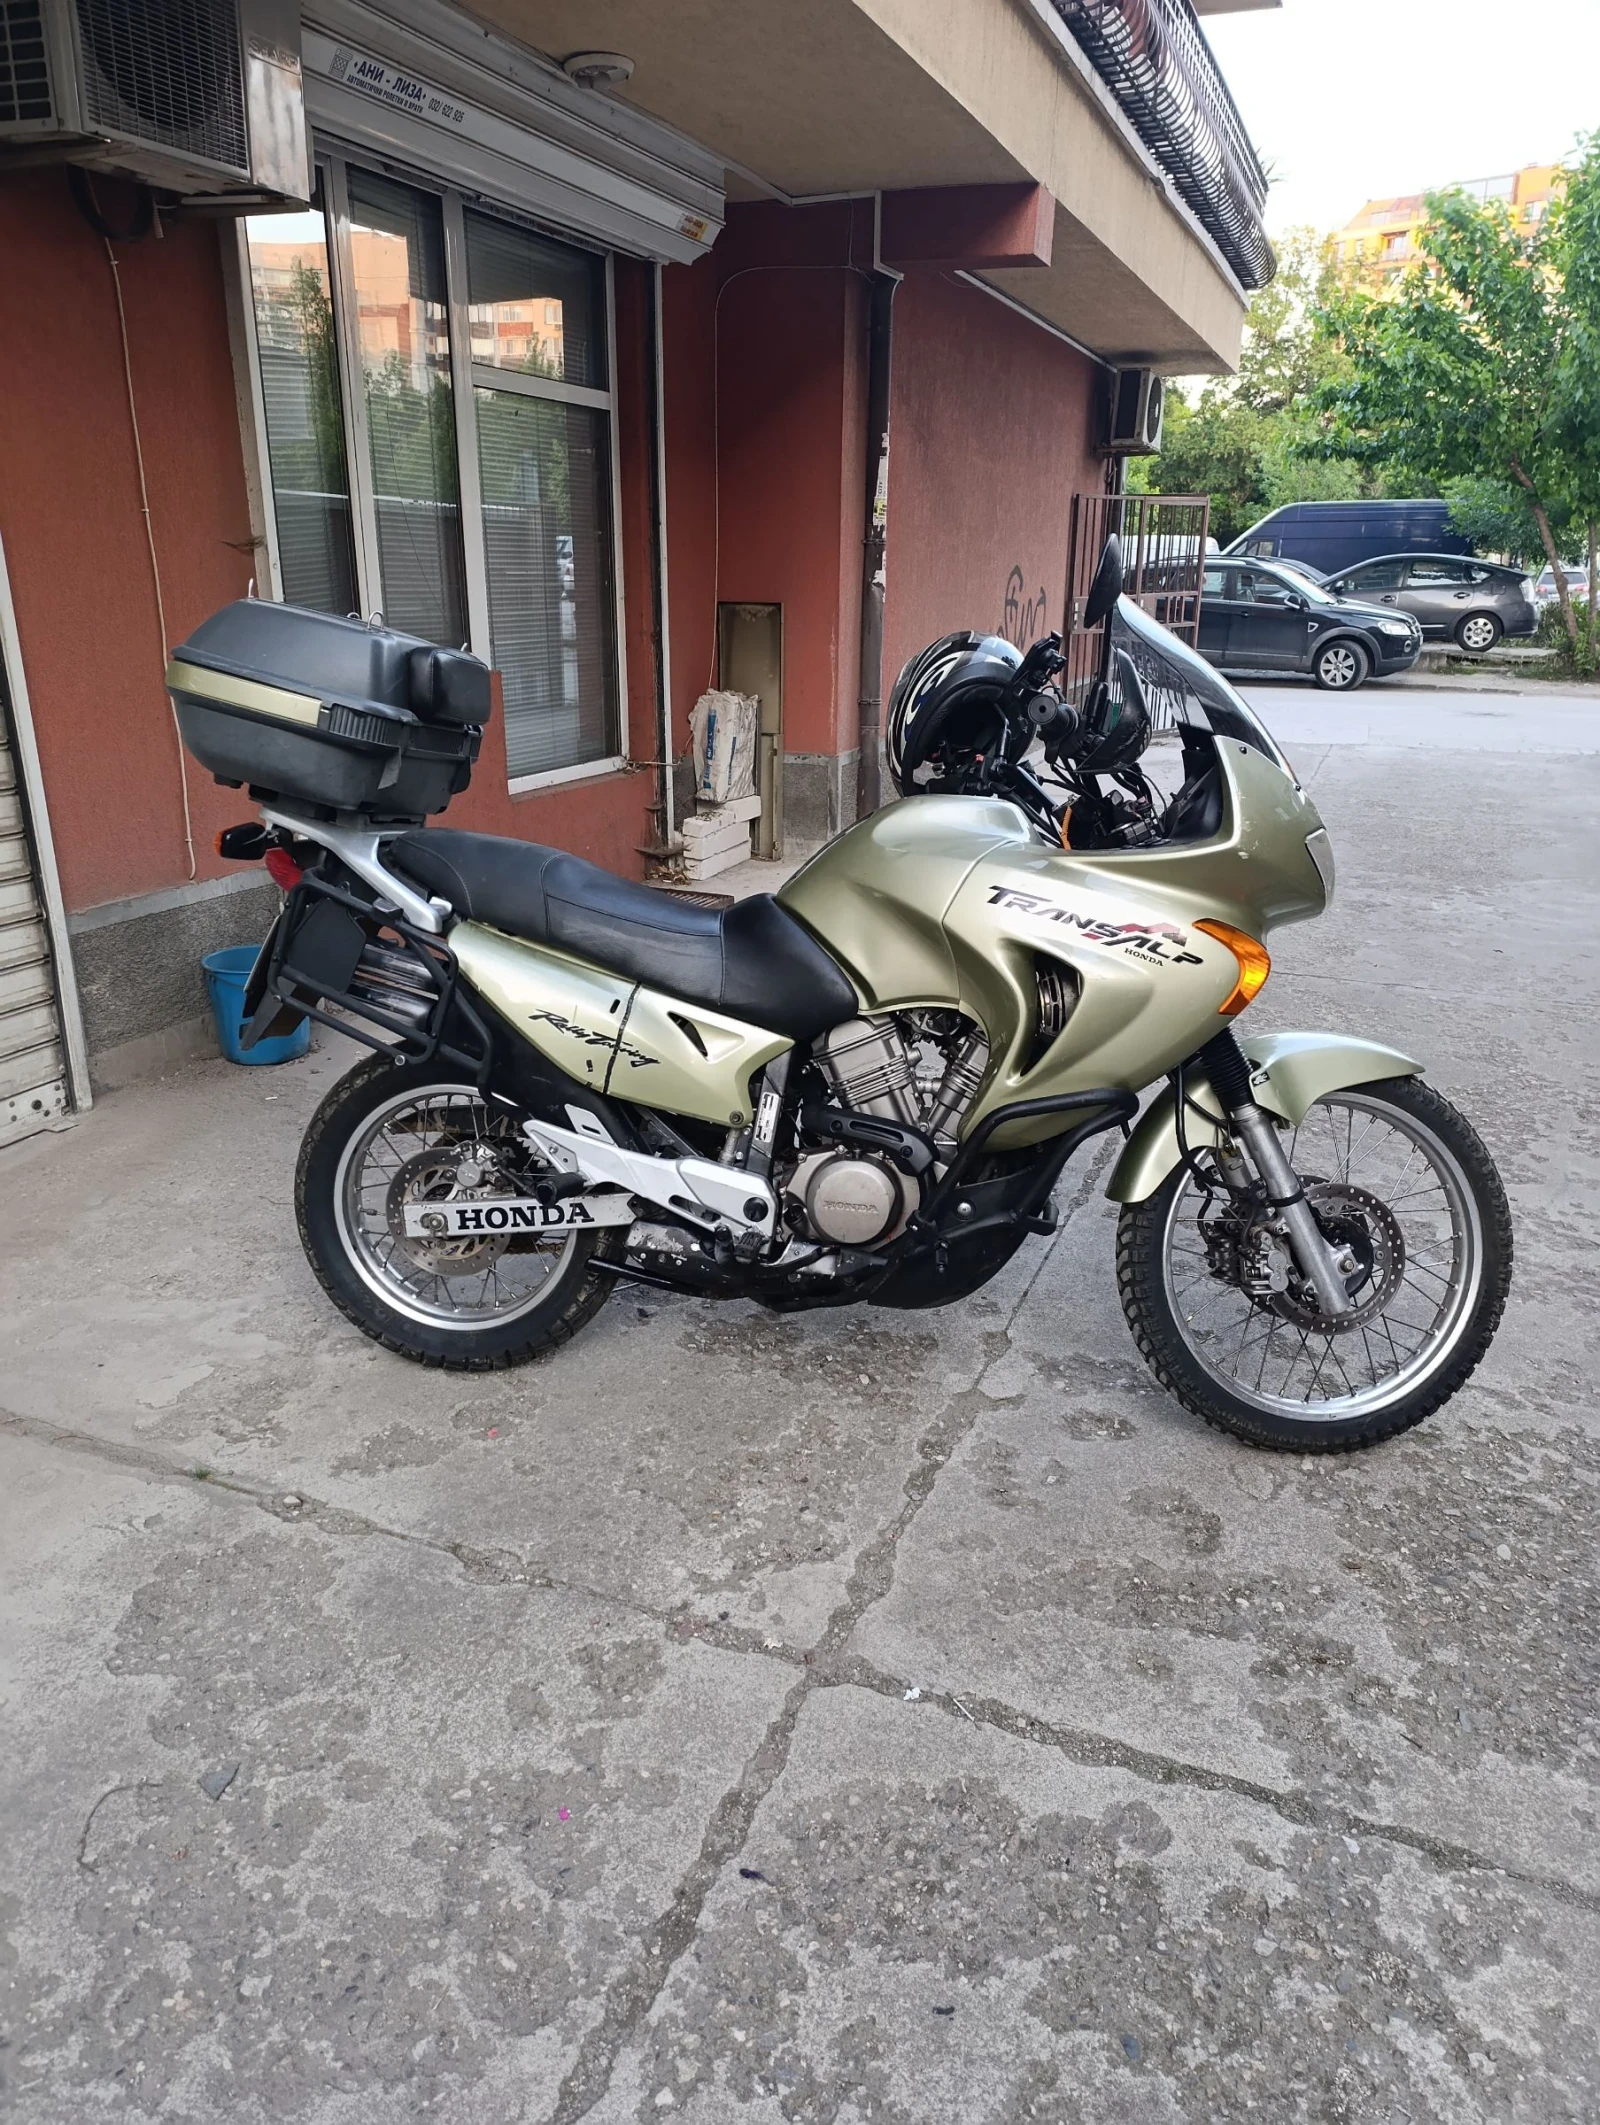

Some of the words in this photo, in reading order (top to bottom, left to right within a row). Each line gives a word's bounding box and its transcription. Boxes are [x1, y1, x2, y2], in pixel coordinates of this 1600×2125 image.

[357, 61, 385, 83] АНИ
[392, 77, 423, 101] ЛИЗА
[986, 885, 1204, 966] TRANSALP
[1124, 947, 1164, 967] HONDA
[528, 1008, 591, 1038] Rally
[455, 1202, 595, 1230] HONDA
[823, 1200, 879, 1215] HONDA
